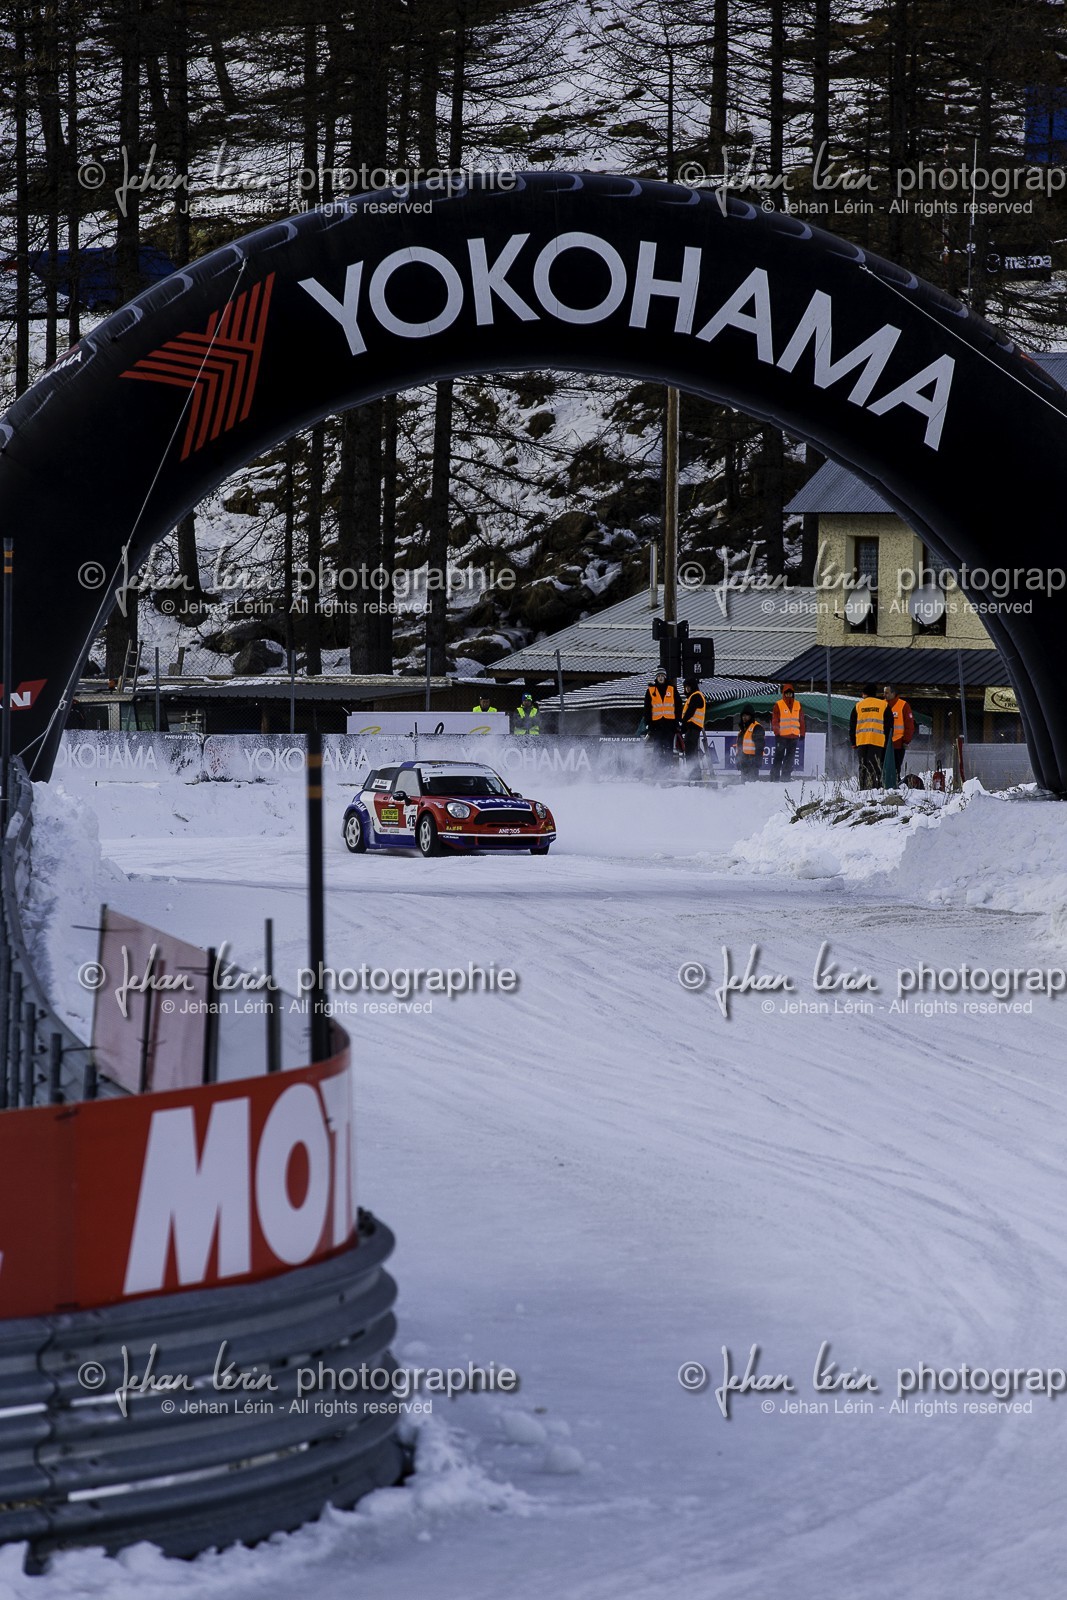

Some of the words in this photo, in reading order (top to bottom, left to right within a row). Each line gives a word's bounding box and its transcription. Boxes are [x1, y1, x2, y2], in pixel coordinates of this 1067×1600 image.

[298, 231, 955, 451] YOKOHAMA
[54, 743, 158, 770] OKOHAMA
[244, 747, 372, 772] YOKOAMA
